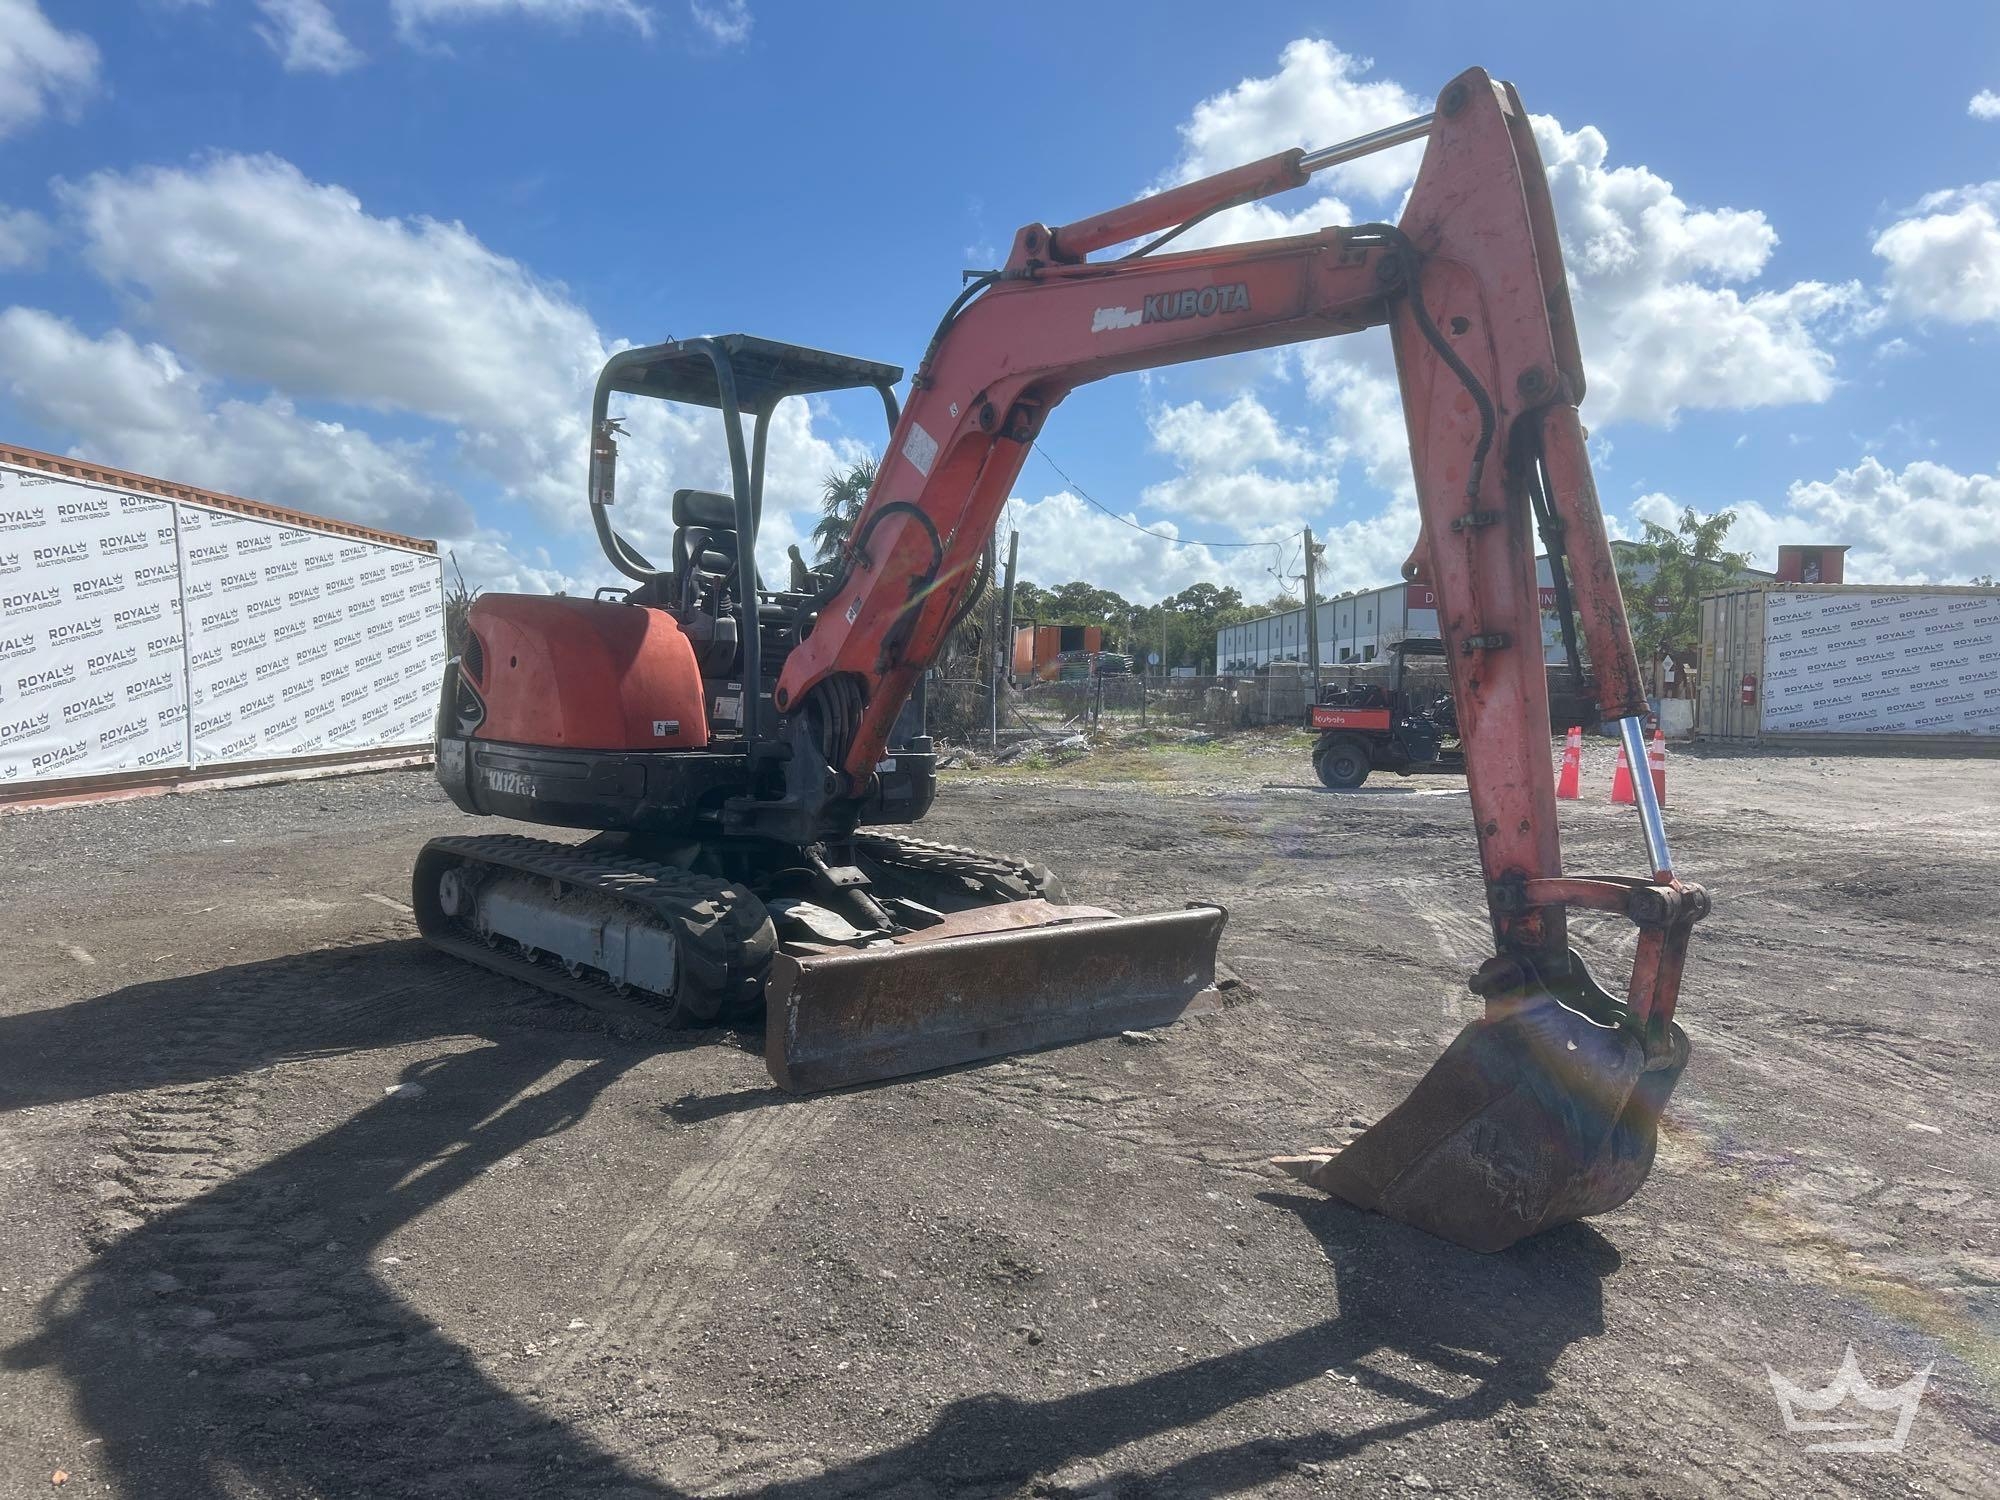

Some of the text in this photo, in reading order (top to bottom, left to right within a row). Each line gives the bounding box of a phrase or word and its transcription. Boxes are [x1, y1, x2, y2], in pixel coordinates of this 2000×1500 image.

[1142, 282, 1250, 322] KUBOTA
[57, 502, 99, 516] ROYAL
[0, 510, 33, 524] OYAL
[60, 511, 110, 524] AUCTION GROUP
[0, 524, 21, 532] CTION
[99, 534, 138, 549] ROYAL
[237, 537, 265, 549] ROYAL
[33, 545, 77, 561] ROYAL
[102, 543, 149, 556] AUCTION GROUP
[190, 546, 221, 559] ROYAL
[340, 546, 362, 558] ROYAL
[37, 554, 89, 569] AUCTION GROUP
[305, 554, 328, 566] ROYAL
[0, 566, 21, 574] ROUP
[134, 565, 170, 580] ROYAL
[265, 563, 291, 576] ROYAL
[391, 562, 409, 572] ROYAL
[221, 573, 250, 587] ROYAL
[360, 570, 380, 581] ROYAL
[73, 577, 114, 594] ROYAL
[137, 577, 161, 588] AUCTION
[326, 578, 349, 591] ROYAL
[76, 585, 125, 601] AUCTION GROUP
[289, 588, 313, 601] ROYAL
[381, 591, 400, 603] ROYAL
[2, 591, 49, 609] ROYAL
[247, 599, 274, 613] ROYAL
[1871, 596, 1902, 605] ROYAL
[1948, 601, 1979, 610] ROYAL
[6, 599, 62, 617] AUCTION GROUP
[349, 601, 370, 613] ROYAL
[1822, 605, 1853, 614] ROYAL
[114, 606, 151, 623] ROYAL
[201, 611, 232, 626] ROYAL
[313, 611, 336, 624] ROYAL
[398, 612, 416, 624] ROYAL
[1773, 613, 1804, 622] ROYAL
[1900, 610, 1930, 618] ROYAL
[1974, 615, 2000, 624] ROYA
[117, 614, 162, 631] AUCTION GROUP
[368, 622, 388, 635] ROYAL
[1851, 618, 1882, 627] ROYAL
[1925, 623, 1956, 632] ROYAL
[49, 621, 92, 640] ROYAL
[274, 623, 300, 637] ROYAL
[1802, 626, 1833, 635] ROYAL
[1876, 632, 1907, 641] ROYAL
[52, 629, 104, 648] AUCTION GROUP
[147, 634, 182, 652] ROYAL
[231, 636, 259, 651] ROYAL
[334, 634, 356, 647] ROYAL
[416, 631, 433, 643] ROYAL
[1954, 637, 1984, 646] ROYAL
[388, 642, 407, 655] ROYAL
[1828, 640, 1858, 649] ROYAL
[1905, 645, 1936, 654] ROYAL
[11, 647, 36, 658] GROUP
[150, 647, 174, 659] AUCTION
[191, 648, 213, 664] OYAL
[297, 646, 321, 661] ROYAL
[1779, 649, 1810, 658] ROYAL
[1856, 653, 1887, 662] ROYAL
[87, 651, 127, 670] ROYAL
[356, 654, 376, 668] ROYAL
[1808, 662, 1838, 671] ROYAL
[1930, 659, 1961, 668] ROYAL
[90, 658, 138, 677] AUCTION GROUP
[256, 660, 283, 675] ROYAL
[405, 661, 422, 674] ROYAL
[1882, 667, 1912, 676] ROYAL
[18, 669, 63, 690] ROYAL
[321, 667, 344, 682] ROYAL
[374, 674, 394, 688] ROYAL
[1833, 676, 1864, 684] ROYAL
[1959, 672, 1989, 681] ROYAL
[21, 676, 76, 698] AUCTION GROUP
[126, 677, 163, 696] ROYAL
[211, 675, 241, 692] ROYAL
[283, 681, 308, 697] ROYAL
[1784, 684, 1815, 693] ROYAL
[1910, 681, 1941, 690] ROYAL
[129, 683, 173, 703] AUCTION GROUP
[341, 688, 363, 702] ROYAL
[394, 692, 412, 706] ROYAL
[1862, 689, 1892, 698] ROYAL
[1936, 695, 1966, 703] ROYAL
[63, 696, 104, 718] ROYAL
[240, 697, 268, 714] ROYAL
[1813, 697, 1844, 706] ROYAL
[1887, 703, 1917, 712] ROYAL
[66, 702, 116, 725] AUCTION GROUP
[158, 704, 188, 720] ROYA
[305, 703, 328, 719] ROYAL
[363, 706, 383, 721] ROYAL
[1839, 711, 1869, 720] ROYAL
[1964, 708, 1994, 717] ROYAL
[194, 715, 225, 734] ROYAL
[1790, 719, 1820, 728] ROYAL
[1916, 716, 1946, 725] ROYAL
[1, 718, 38, 738] OYAL
[99, 722, 138, 744] ROYAL
[265, 719, 291, 737] ROYAL
[329, 722, 351, 738] ROYAL
[381, 725, 400, 740] ROYAL
[1867, 724, 1897, 733] ROYAL
[0, 725, 50, 746] UCTION GROUP
[102, 728, 148, 751] AUCTION GROUP
[221, 738, 250, 756] ROYAL
[292, 739, 316, 756] ROYAL
[32, 746, 76, 769] ROYAL
[138, 745, 174, 767] ROYAL
[36, 751, 88, 777] AUCTION GROUP
